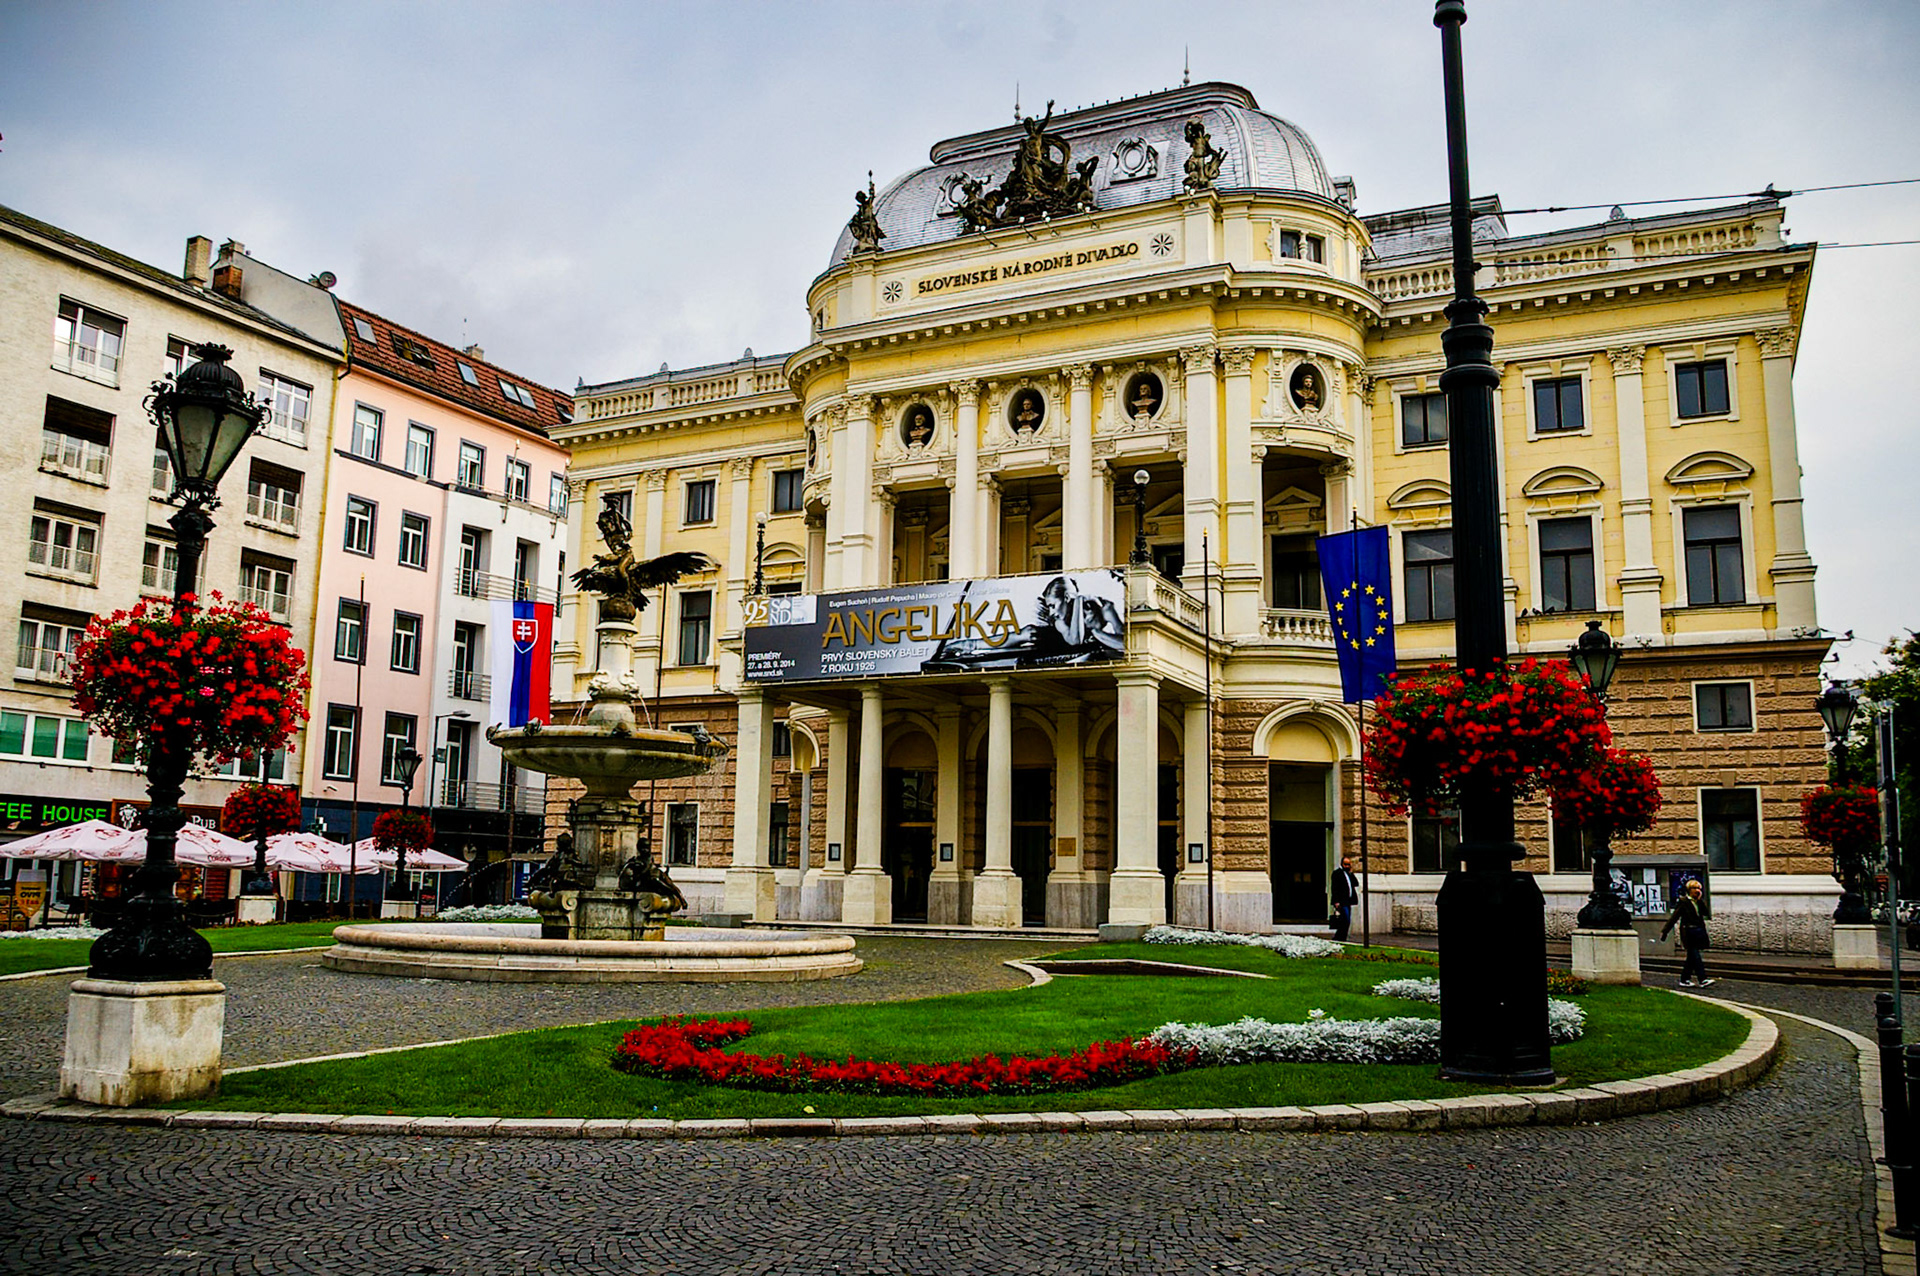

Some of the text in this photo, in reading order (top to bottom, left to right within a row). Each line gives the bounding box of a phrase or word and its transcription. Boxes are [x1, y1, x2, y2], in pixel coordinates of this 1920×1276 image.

[918, 242, 1139, 292] SLOVENSKÉ NÁRODNÉ DIVADLO
[829, 599, 847, 608] Eugen
[745, 600, 769, 624] 95
[822, 599, 1020, 647] ANGELIKA
[748, 651, 781, 661] PREMIÉRY
[821, 647, 929, 662] PRVÝ SLOVENSKÝ BALET
[780, 659, 796, 668] 2014
[821, 661, 876, 673] Z ROKU 1926
[42, 804, 107, 822] HOUSE
